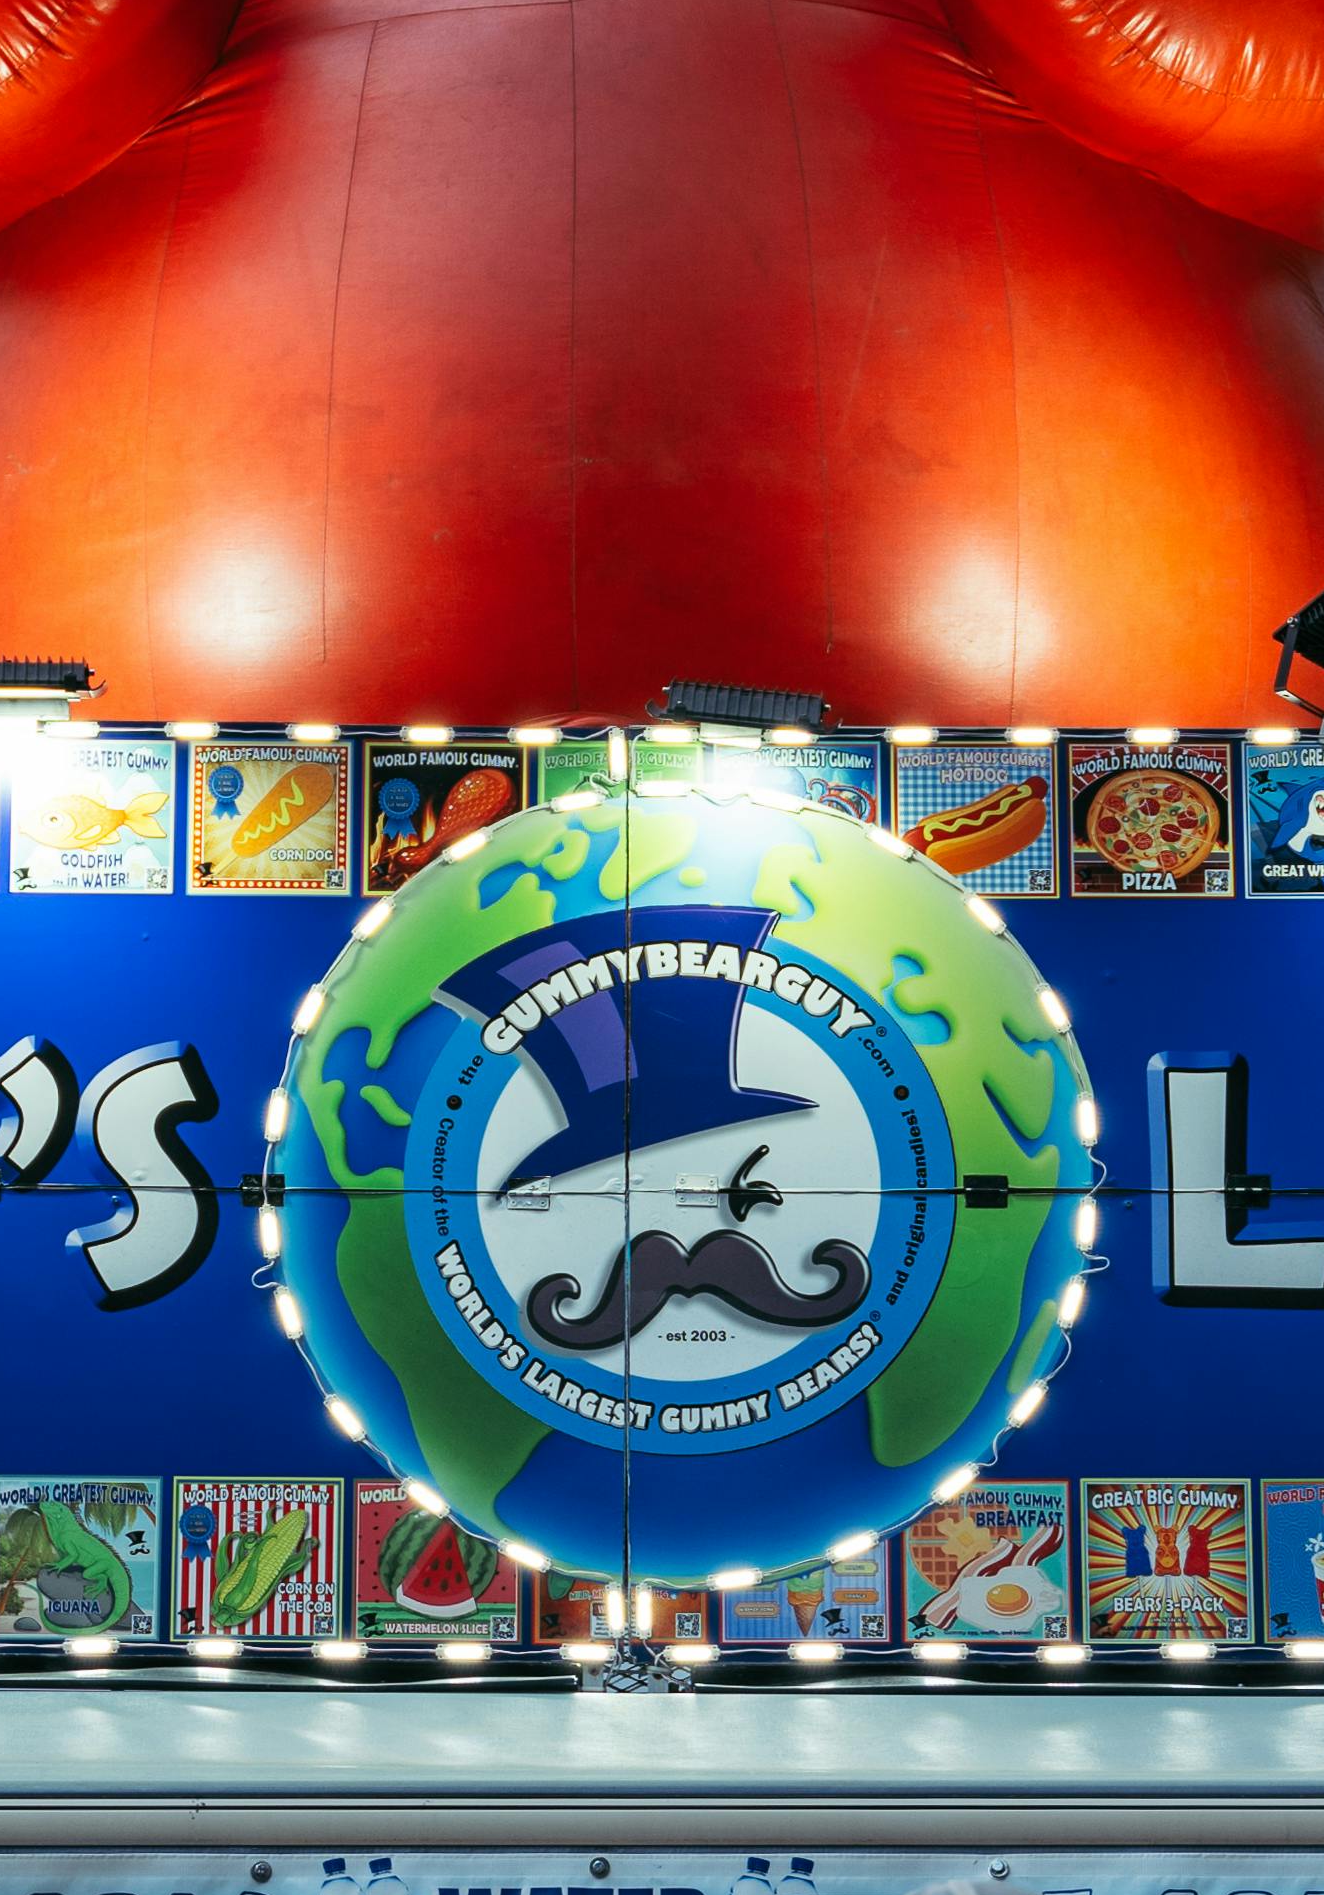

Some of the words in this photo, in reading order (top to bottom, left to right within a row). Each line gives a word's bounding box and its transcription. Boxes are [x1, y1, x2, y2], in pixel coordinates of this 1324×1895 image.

[1122, 872, 1177, 891] PIZZA
[458, 1054, 485, 1088] the
[438, 1116, 455, 1181] Creator
[901, 1108, 927, 1189] candies!
[432, 1183, 446, 1201] of
[434, 1205, 451, 1238] the
[904, 1195, 928, 1269] original
[884, 1270, 910, 1307] and
[434, 1240, 528, 1373] WORLD'S
[521, 1357, 652, 1431] LARGEST
[660, 1392, 771, 1434] GUMMY
[665, 1329, 688, 1343] est
[690, 1329, 728, 1343] 2003
[48, 1599, 101, 1616] IGUANA
